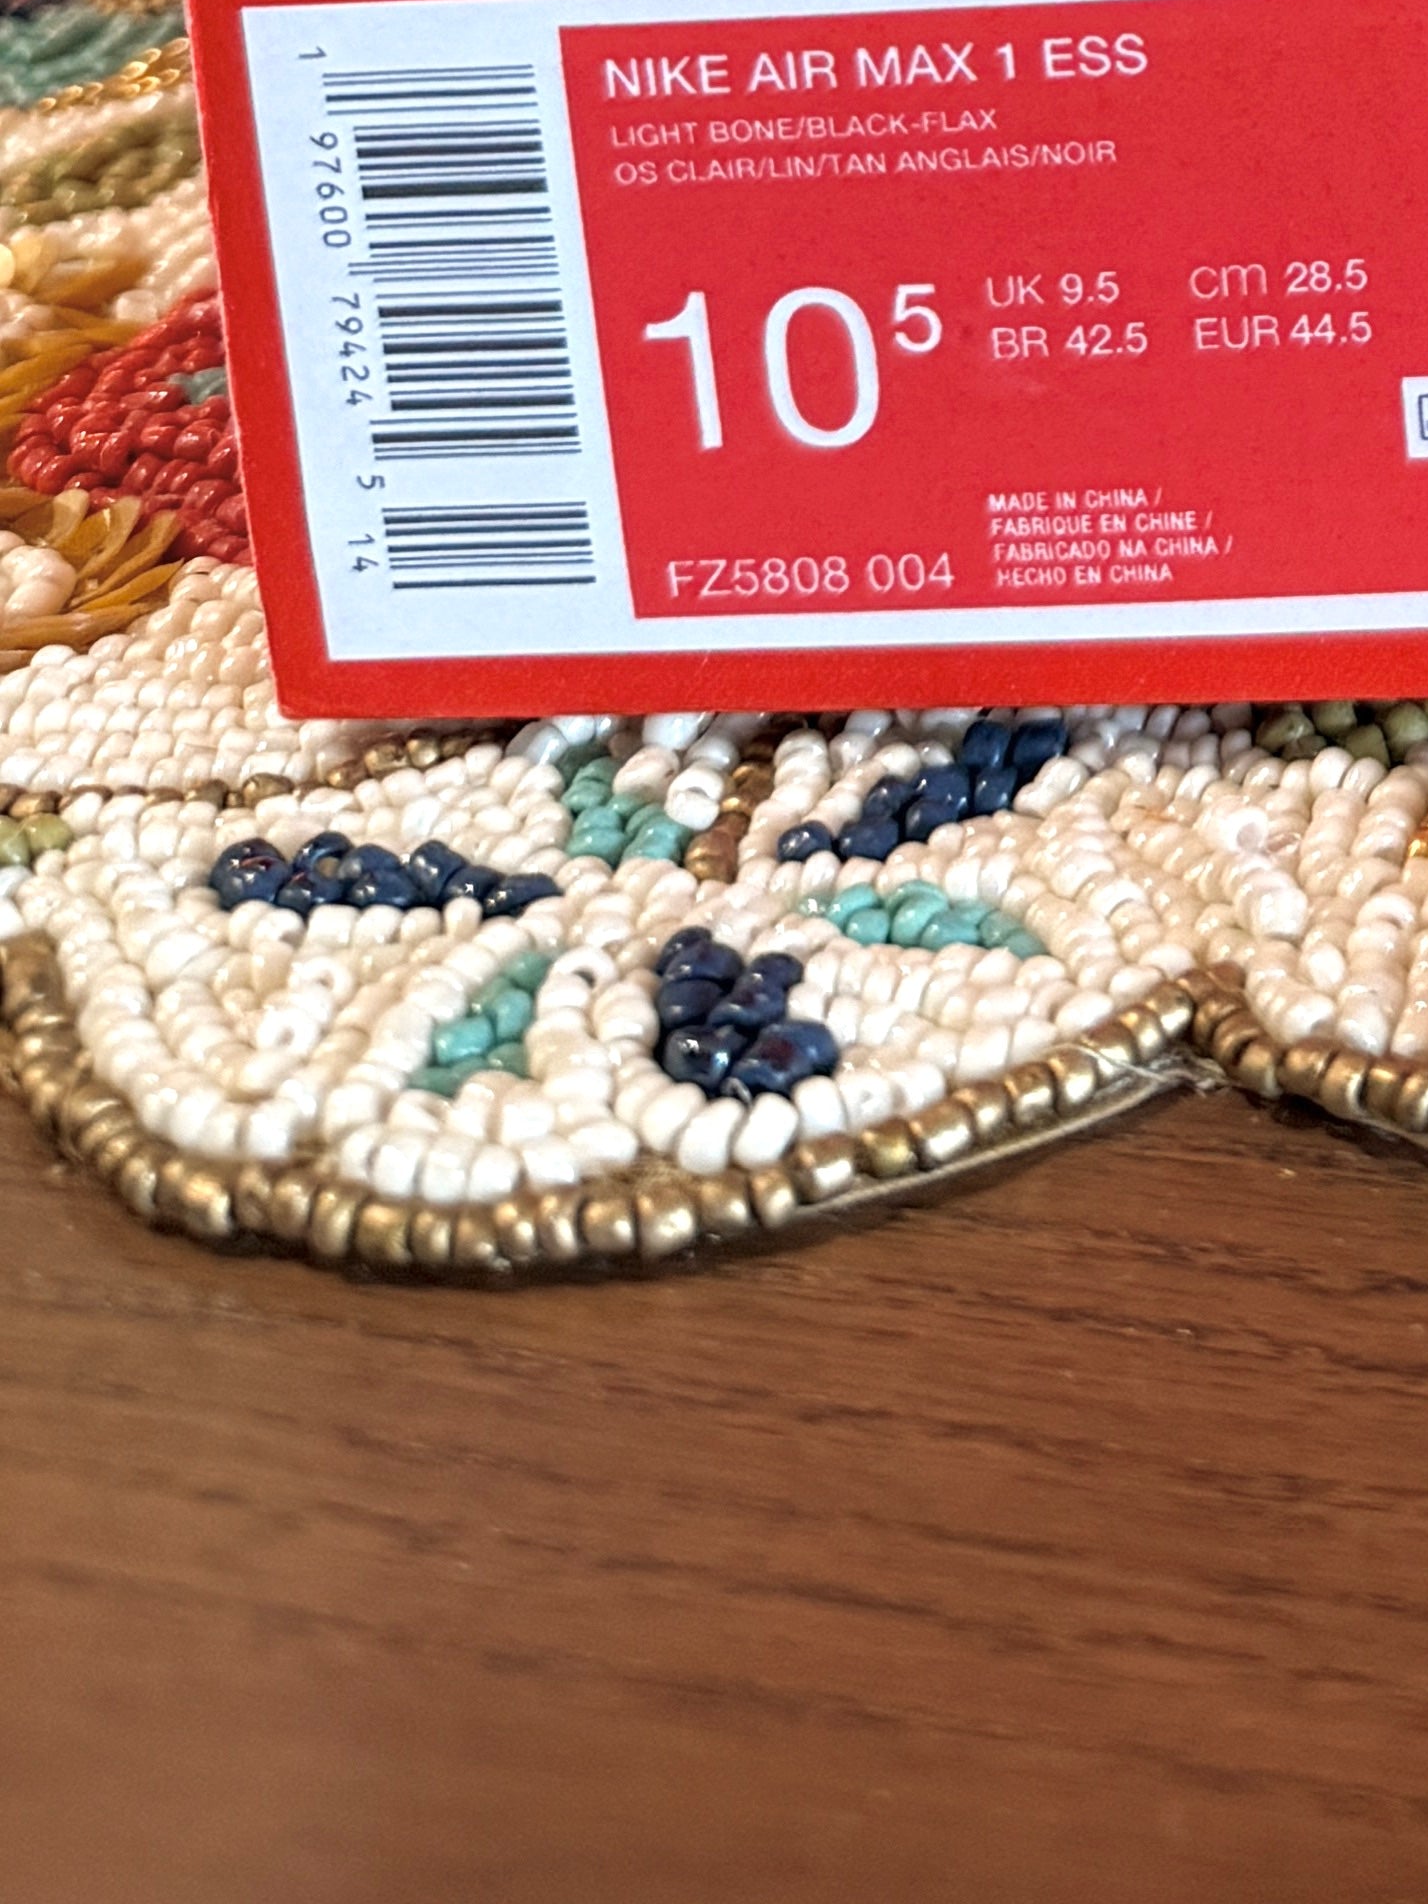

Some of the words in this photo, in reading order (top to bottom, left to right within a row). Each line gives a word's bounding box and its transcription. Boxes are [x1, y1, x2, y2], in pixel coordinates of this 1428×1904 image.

[603, 54, 732, 98] NIKE
[746, 49, 838, 93] AIR
[855, 41, 978, 88] MAX
[995, 41, 1016, 81] 1
[1041, 33, 1148, 80] ESS
[609, 121, 698, 148] LIGHT
[708, 108, 998, 144] BONE/BLACK-FLAX
[614, 160, 658, 186] OS
[666, 152, 887, 183] CLAIR/LIN/TAN
[894, 139, 1118, 174] ANGLAIS/NOIR
[985, 273, 1045, 308] UK
[1059, 270, 1121, 306] 9.5
[1284, 258, 1370, 294] 28.5
[309, 132, 352, 251] 97600
[331, 293, 374, 409] 79424
[355, 473, 386, 493] 5
[1193, 314, 1280, 351] EUR
[1290, 310, 1373, 346] 44.5
[990, 325, 1050, 360] BR
[1063, 321, 1149, 357] 42.5
[986, 490, 1048, 513] MADE
[1055, 489, 1077, 510] IN
[1084, 487, 1149, 510] CHINA
[989, 513, 1093, 537] FABRIQUE
[1099, 513, 1127, 533] EN
[1134, 509, 1197, 534] CHINE
[347, 534, 381, 575] 14
[993, 538, 1111, 563] FABRICADO
[1118, 538, 1148, 558] NA
[1154, 535, 1220, 557] CHINA
[667, 555, 850, 597] FZ5808
[866, 551, 956, 594] 004
[995, 564, 1067, 588] HECHO
[1073, 564, 1102, 585] EN
[1109, 562, 1174, 584] CHINA
